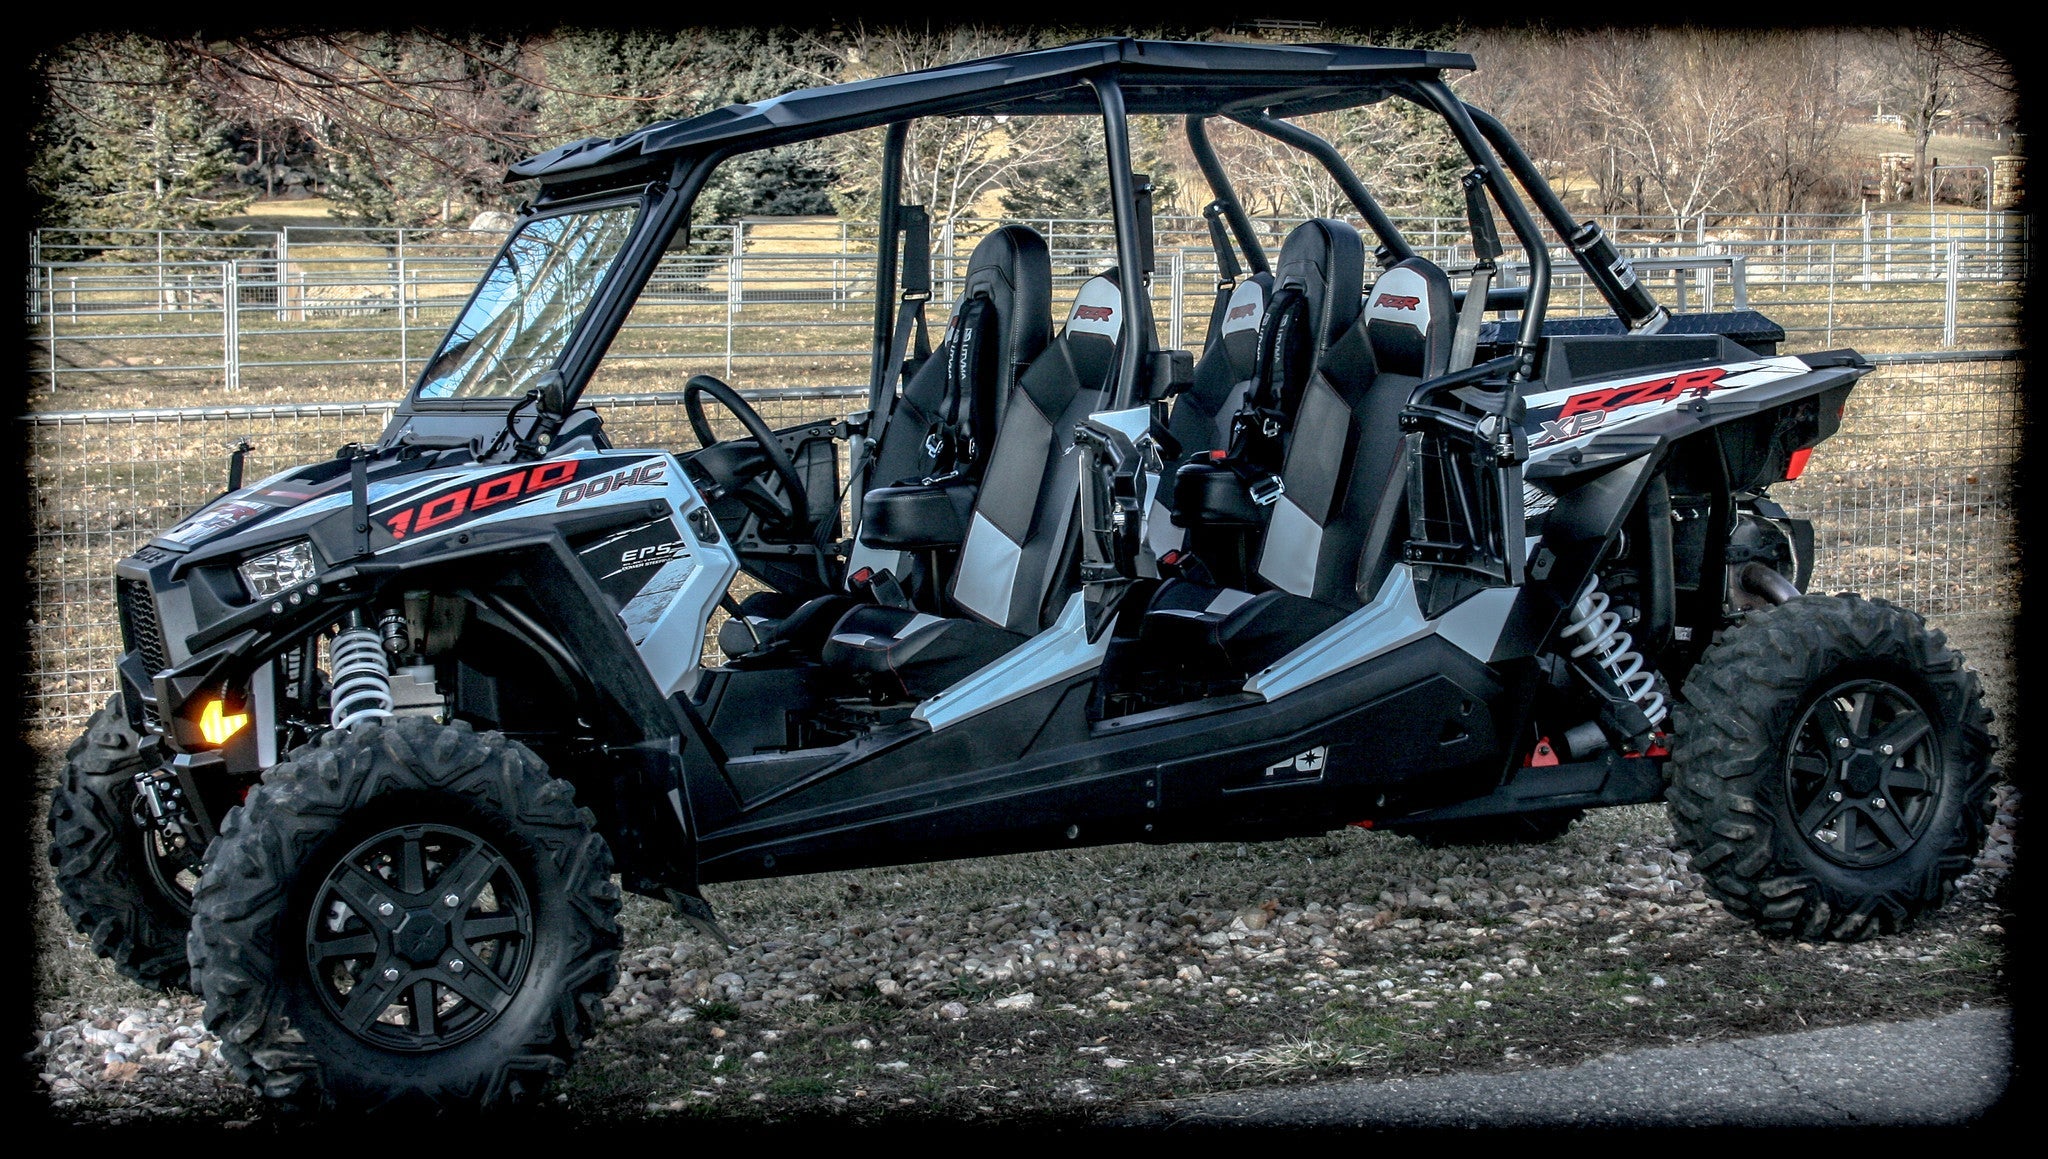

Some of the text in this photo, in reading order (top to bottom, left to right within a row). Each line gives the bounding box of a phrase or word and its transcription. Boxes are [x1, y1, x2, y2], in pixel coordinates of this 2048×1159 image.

[1374, 293, 1420, 311] RZR
[1557, 367, 1728, 420] RZR
[1534, 410, 1606, 446] XP
[387, 459, 580, 540] 1000
[557, 461, 668, 507] DOHC
[621, 541, 674, 562] EPS
